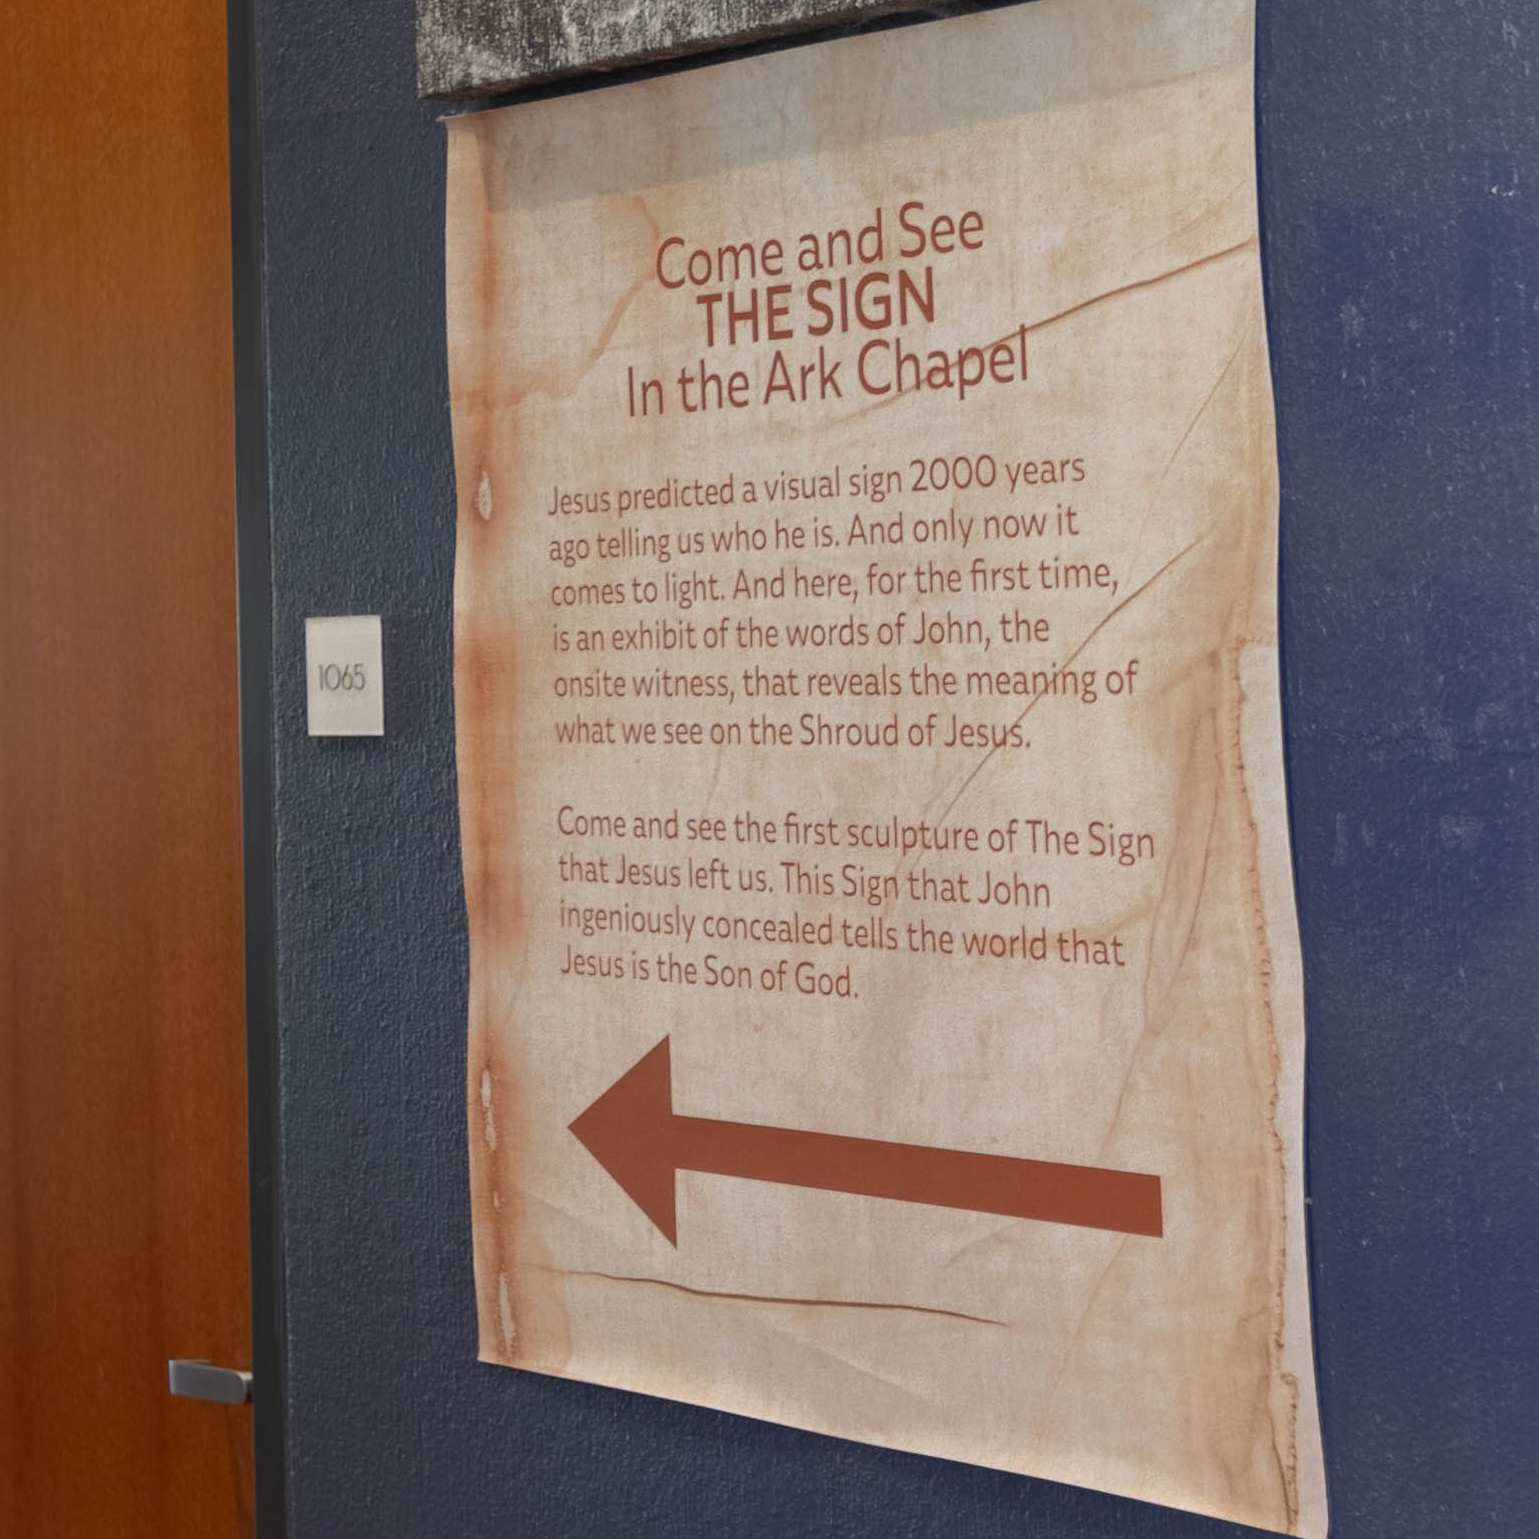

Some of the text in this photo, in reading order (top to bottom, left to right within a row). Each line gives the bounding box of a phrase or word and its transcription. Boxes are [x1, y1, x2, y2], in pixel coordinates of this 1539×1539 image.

[656, 201, 983, 291] Come and See
[696, 265, 934, 347] THE SIGN
[628, 324, 1030, 417] In the Ark Chapel
[548, 454, 1085, 516] Jesus predicted a visual sign 2000 years
[550, 503, 1079, 567] ago telling us who he is. And only now it
[551, 557, 1118, 609] comes to light. And here, for the first time,
[554, 609, 1049, 652] is an exhibit of the words of John, the
[318, 663, 366, 691] 1065
[554, 659, 1139, 704] onsite witness, that reveals the meaning of
[556, 713, 1031, 750] what we see on the Shroud of Jesus.
[558, 805, 1154, 866] Come and see the first sculpture of The Sign
[559, 853, 1050, 907] that Jesus left us. This Sign that John
[561, 899, 1125, 967] ingeniously concealed tells the world that
[561, 945, 858, 997] Jesus is the Son of God.
